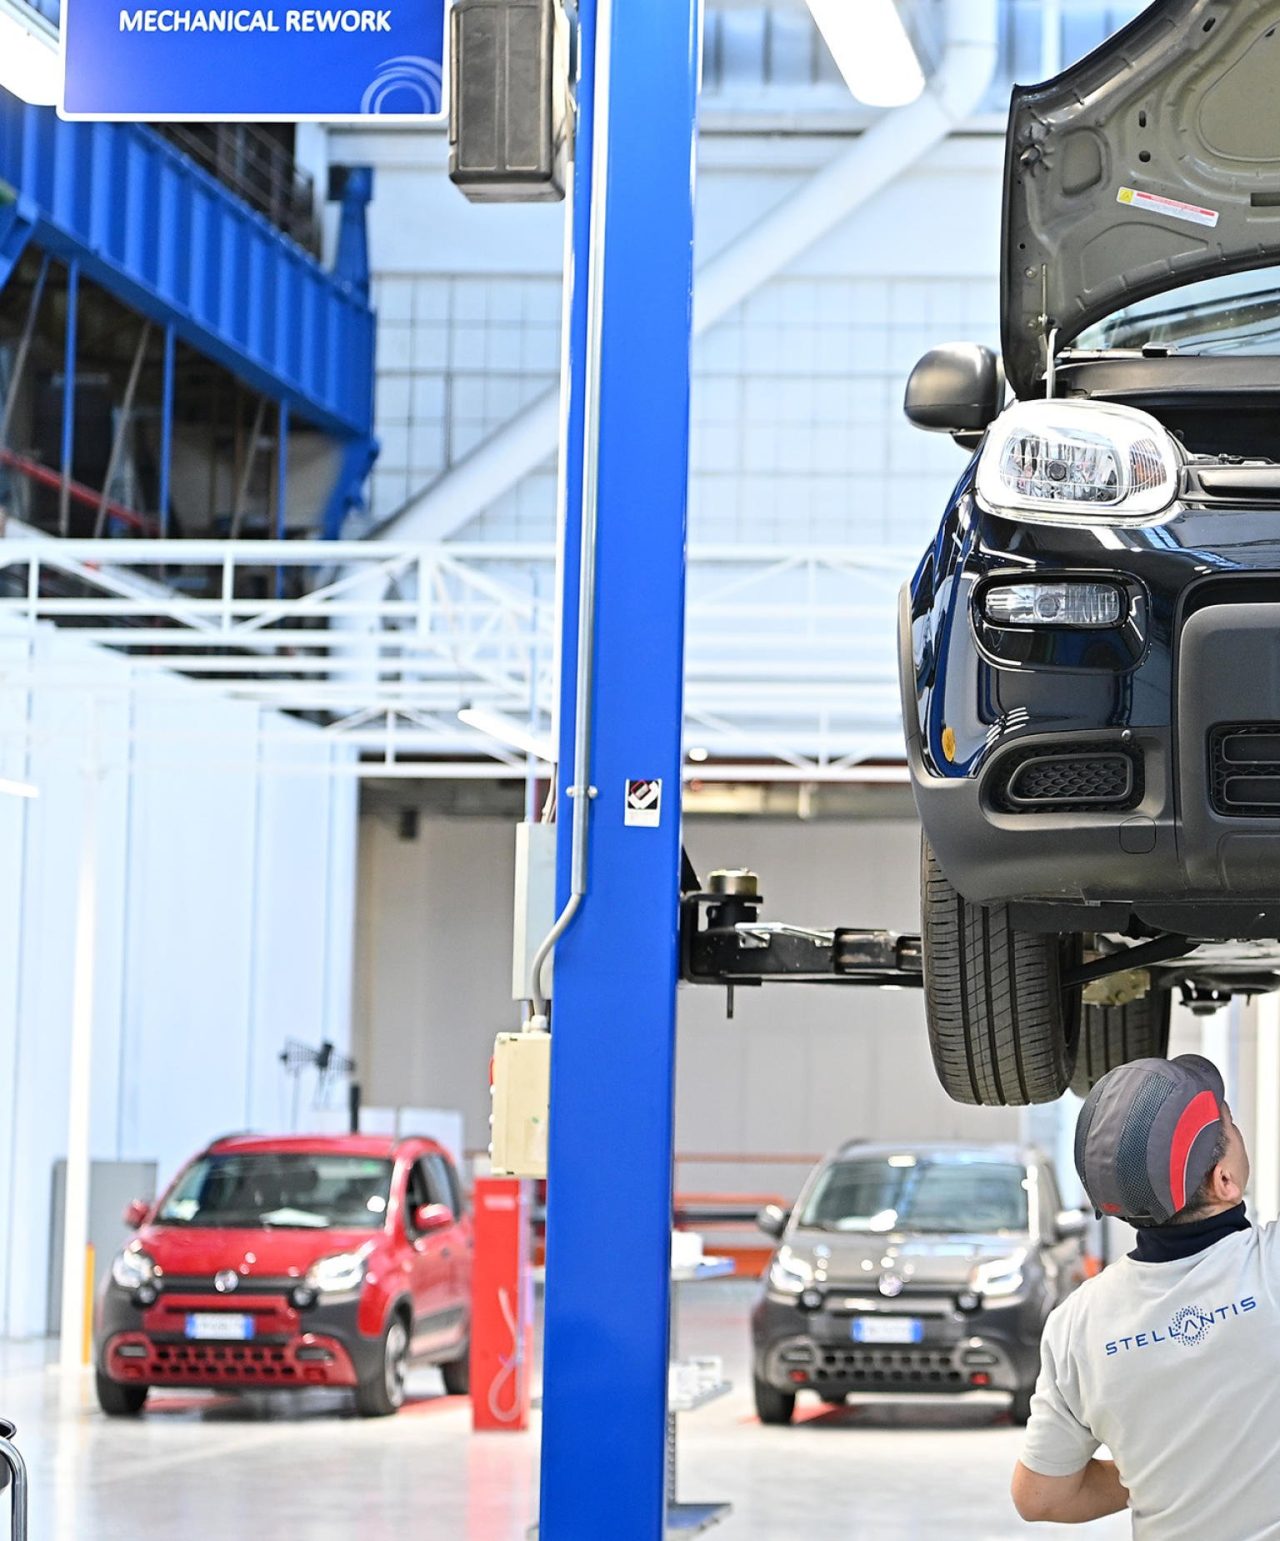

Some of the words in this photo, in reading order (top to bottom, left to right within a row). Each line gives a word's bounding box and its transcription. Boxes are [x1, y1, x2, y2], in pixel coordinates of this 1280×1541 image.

[119, 9, 279, 32] MECHANICAL
[285, 9, 392, 32] REWORK
[1104, 1295, 1257, 1356] STELLANTIS
